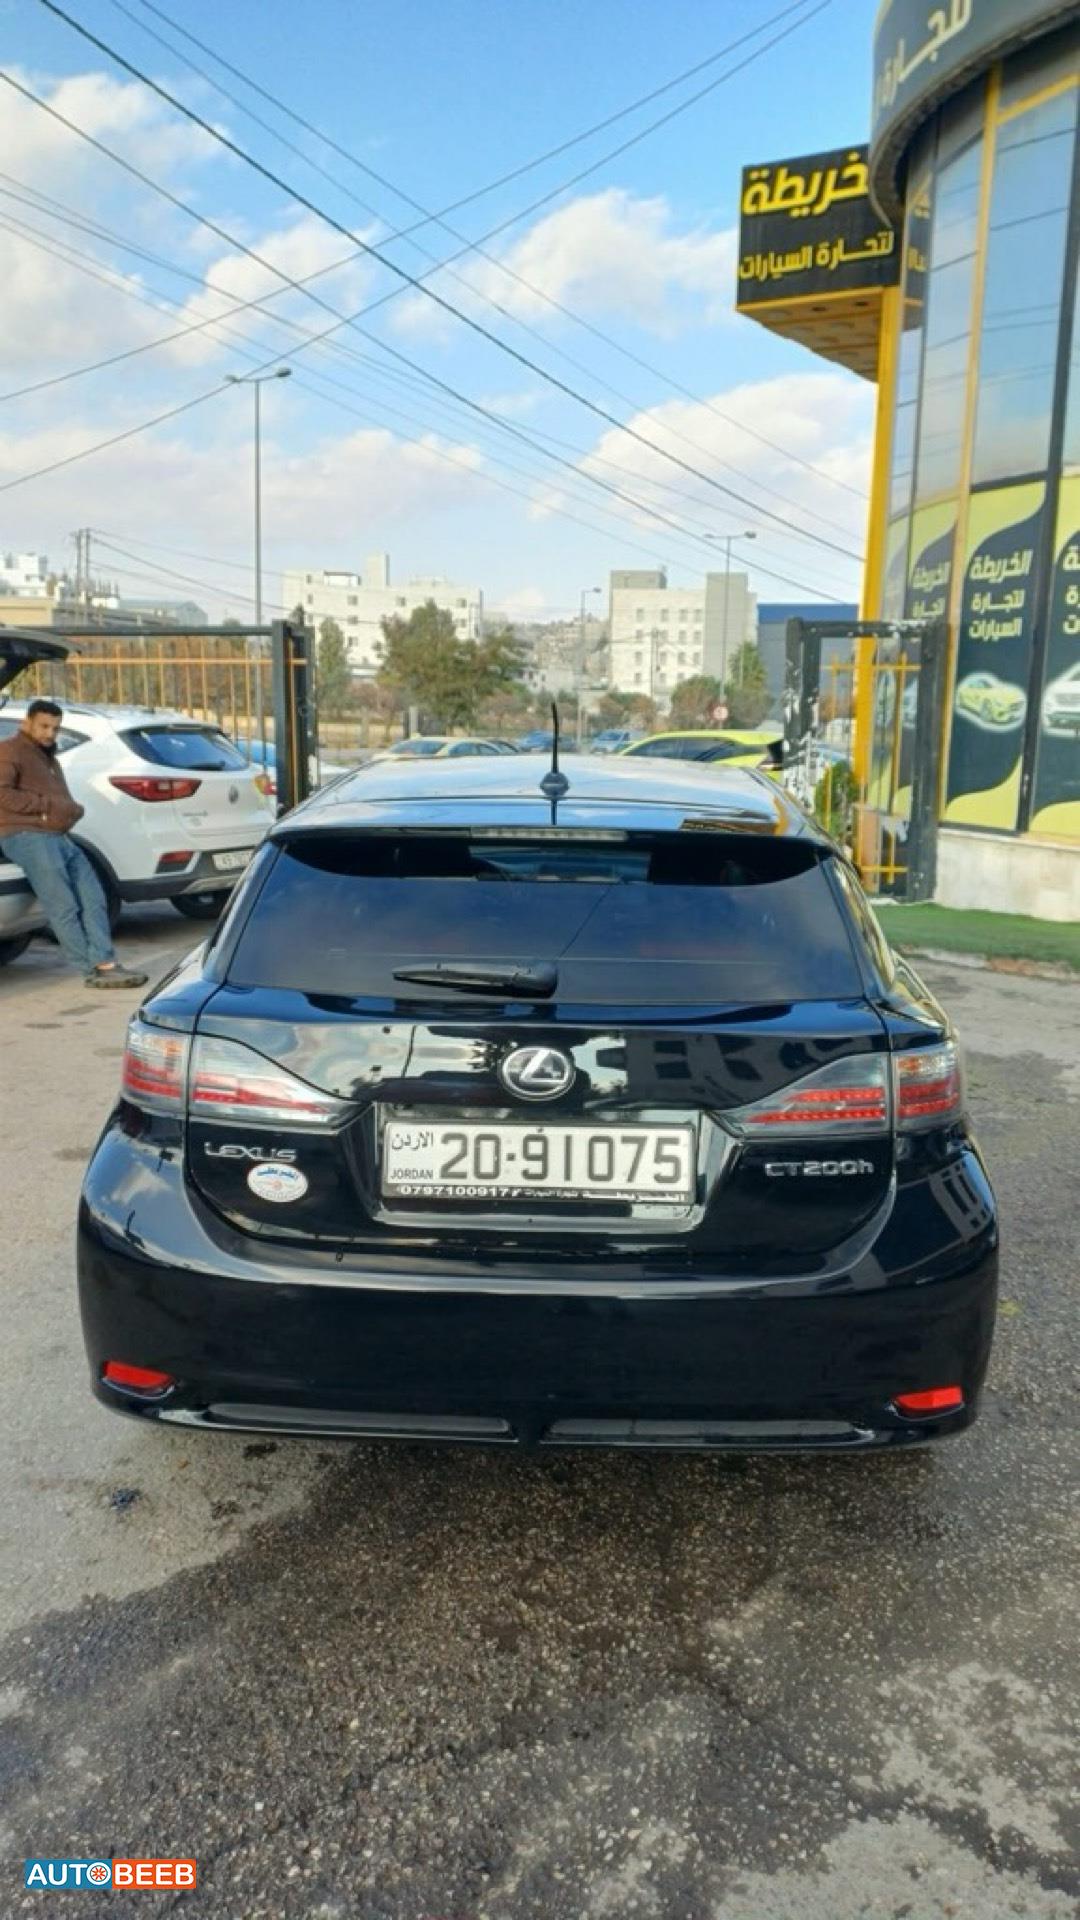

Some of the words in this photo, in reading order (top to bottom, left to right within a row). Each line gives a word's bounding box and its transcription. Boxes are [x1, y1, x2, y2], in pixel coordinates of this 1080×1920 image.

[743, 152, 869, 217] خريطة
[740, 246, 812, 281] السيارات
[969, 550, 1033, 583] الخريطة
[968, 617, 1022, 641] السيارات
[204, 1142, 297, 1162] LEXUS
[391, 1168, 434, 1180] JORDAN
[765, 1160, 874, 1177] CT200h
